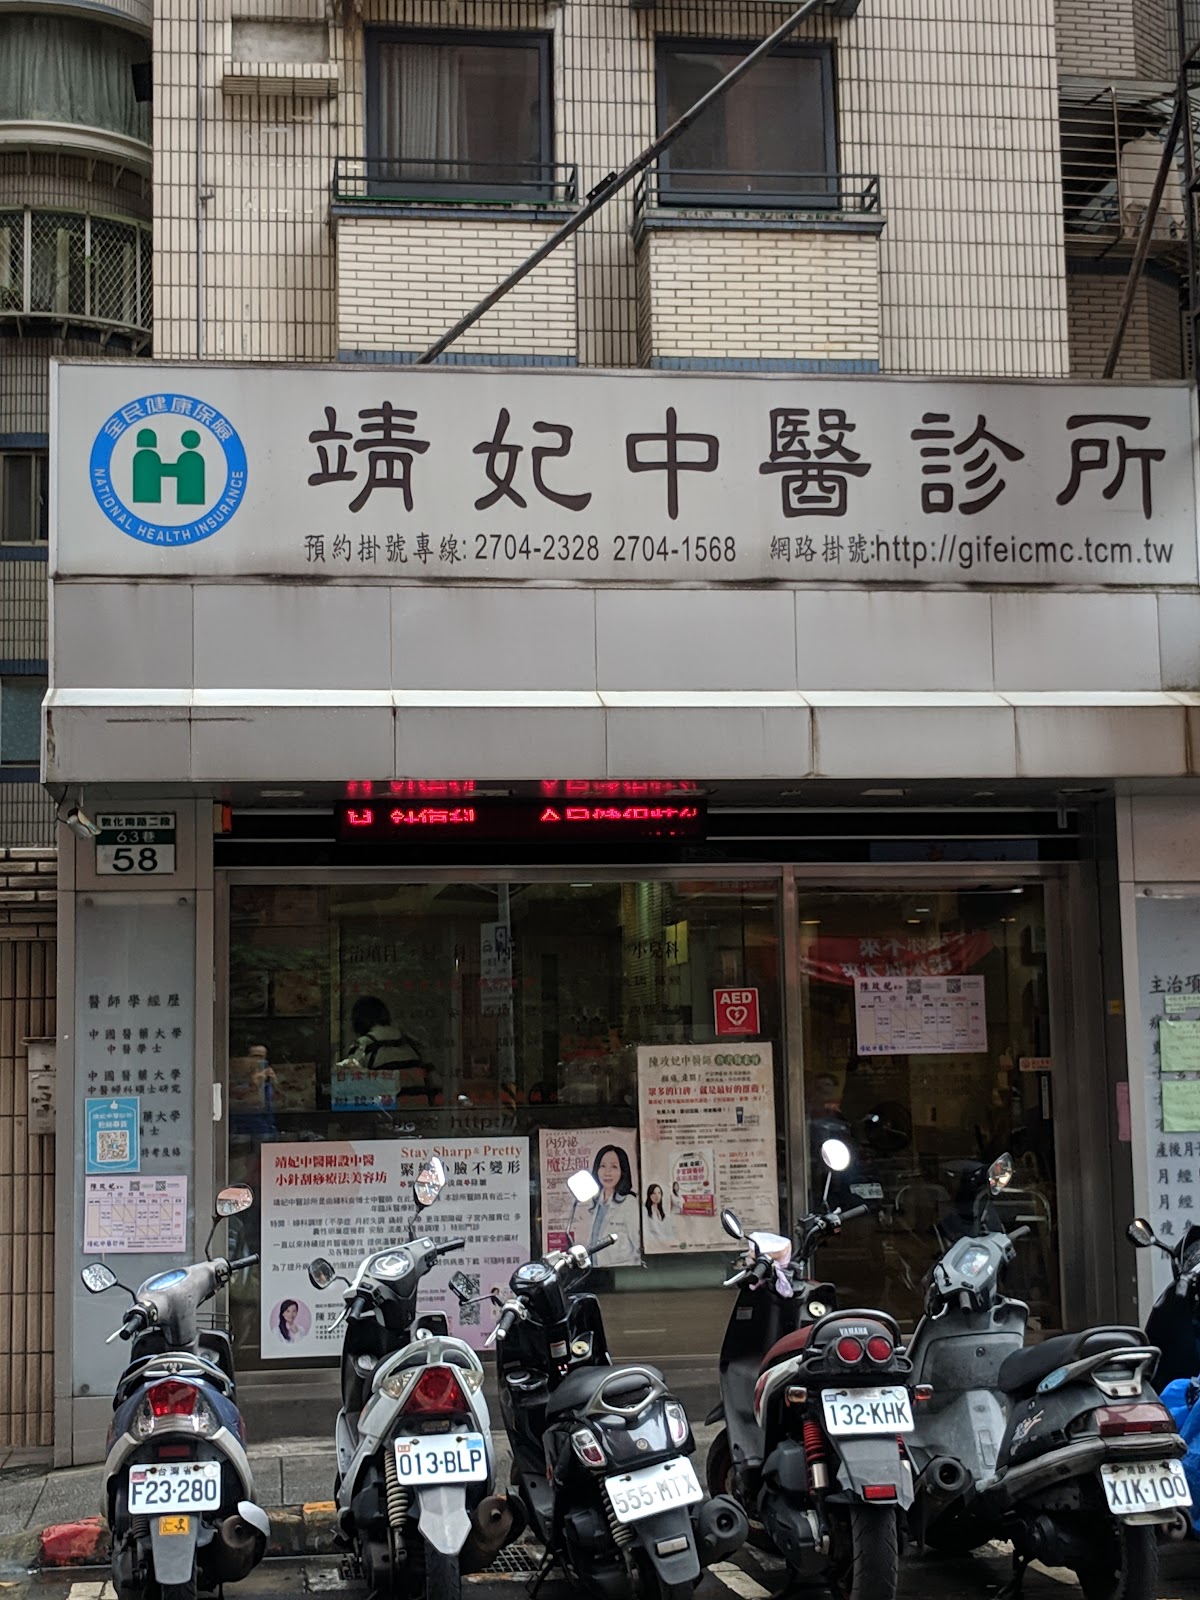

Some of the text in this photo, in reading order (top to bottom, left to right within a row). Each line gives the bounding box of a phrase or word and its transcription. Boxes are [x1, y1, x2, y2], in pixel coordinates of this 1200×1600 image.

[104, 396, 234, 442] 全民健康保險
[307, 400, 1167, 520] 靖妃中醫診所
[94, 468, 244, 542] NATIONAL HEALTH INSURANCE
[474, 534, 599, 563] 2704-2328
[613, 535, 737, 563] 2704-1568
[101, 816, 171, 827] 敦化南路二段
[112, 847, 158, 872] 58
[88, 993, 181, 1009] 醫師學經歷
[720, 991, 753, 1005] AED
[89, 1027, 183, 1040] 中國醫藥大學
[401, 1147, 429, 1160] Stay
[433, 1146, 472, 1159] Sharp
[483, 1145, 523, 1158] Pretty
[275, 1154, 375, 1169] 靖妃中醫附設中醫
[546, 1157, 589, 1172] 魔法師
[838, 1327, 869, 1336] YAMAHA
